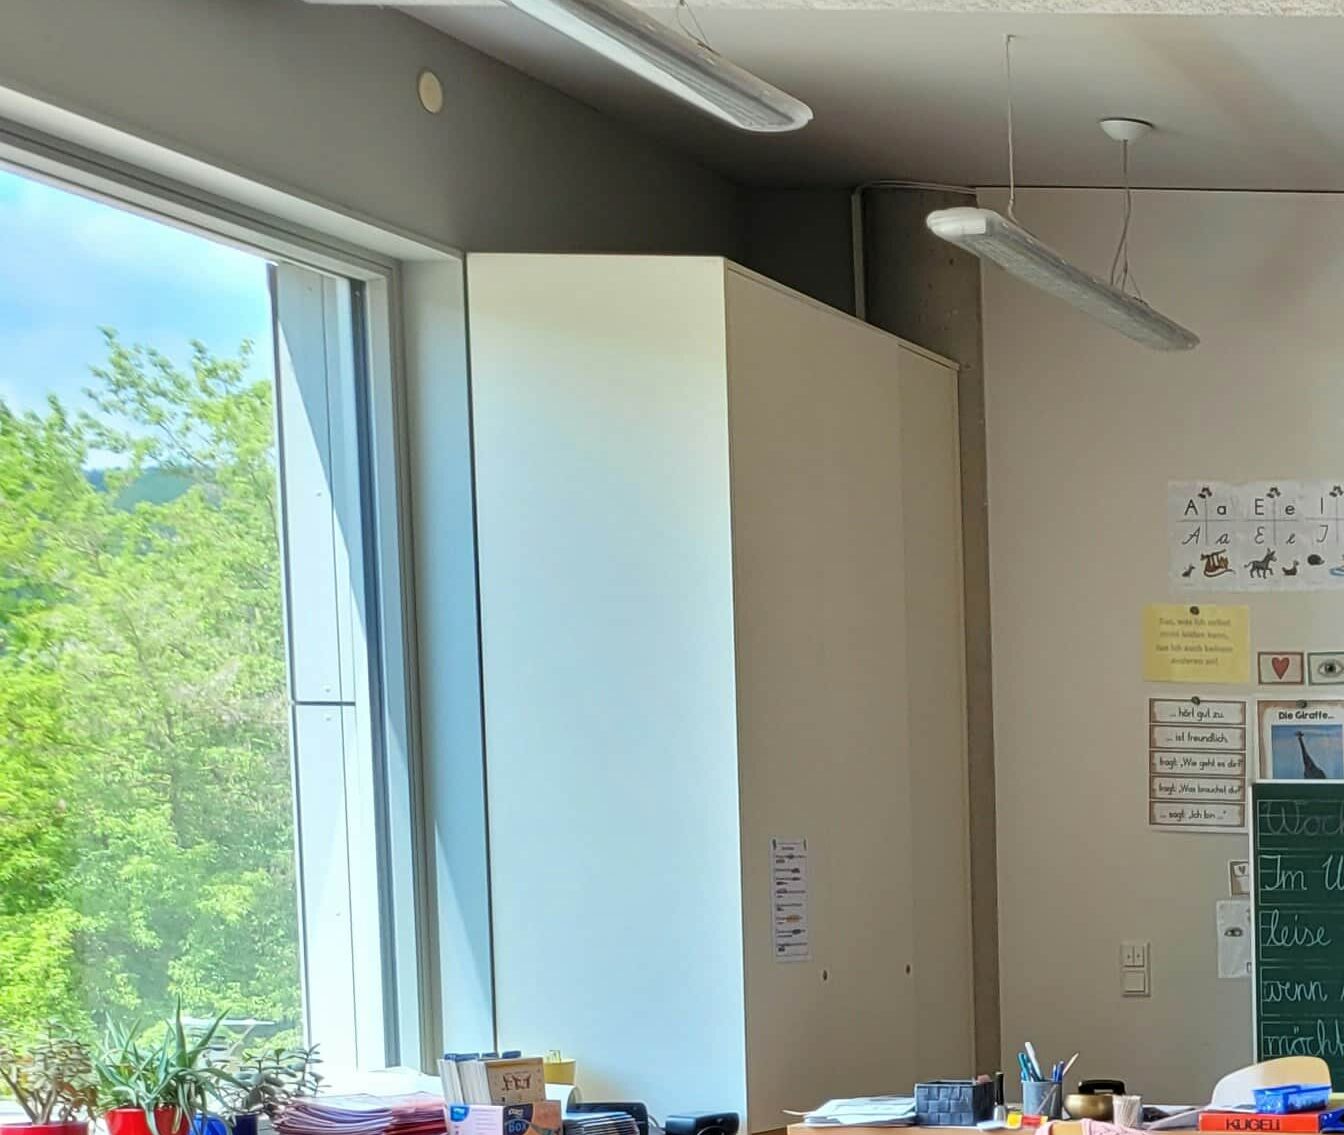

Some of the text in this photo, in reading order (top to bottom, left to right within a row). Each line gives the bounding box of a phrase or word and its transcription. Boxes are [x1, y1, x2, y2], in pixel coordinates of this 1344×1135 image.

[1185, 499, 1198, 515] A
[1217, 506, 1226, 515] a
[1255, 499, 1264, 515] E
[1285, 505, 1295, 515] e
[1278, 711, 1294, 720] Die
[1260, 855, 1307, 891] Im
[1266, 908, 1332, 947] leise
[1264, 980, 1328, 1003] wenn
[1226, 1119, 1281, 1131] KUGELI
